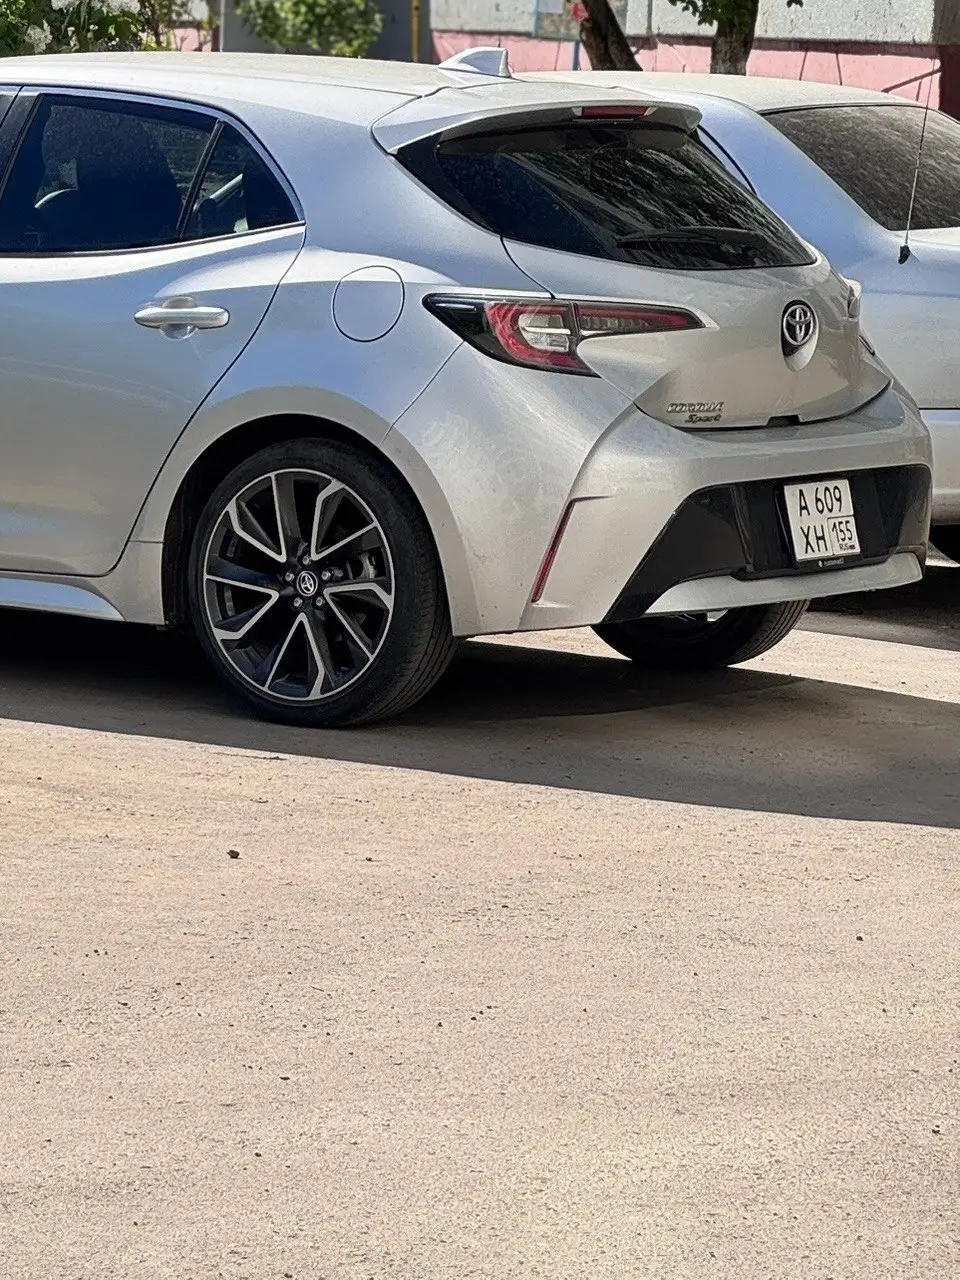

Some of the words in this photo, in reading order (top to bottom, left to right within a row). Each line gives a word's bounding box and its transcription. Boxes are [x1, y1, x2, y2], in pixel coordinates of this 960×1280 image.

[799, 489, 810, 517] А
[815, 485, 842, 514] 609
[800, 524, 828, 554] ХН
[832, 520, 853, 543] 155
